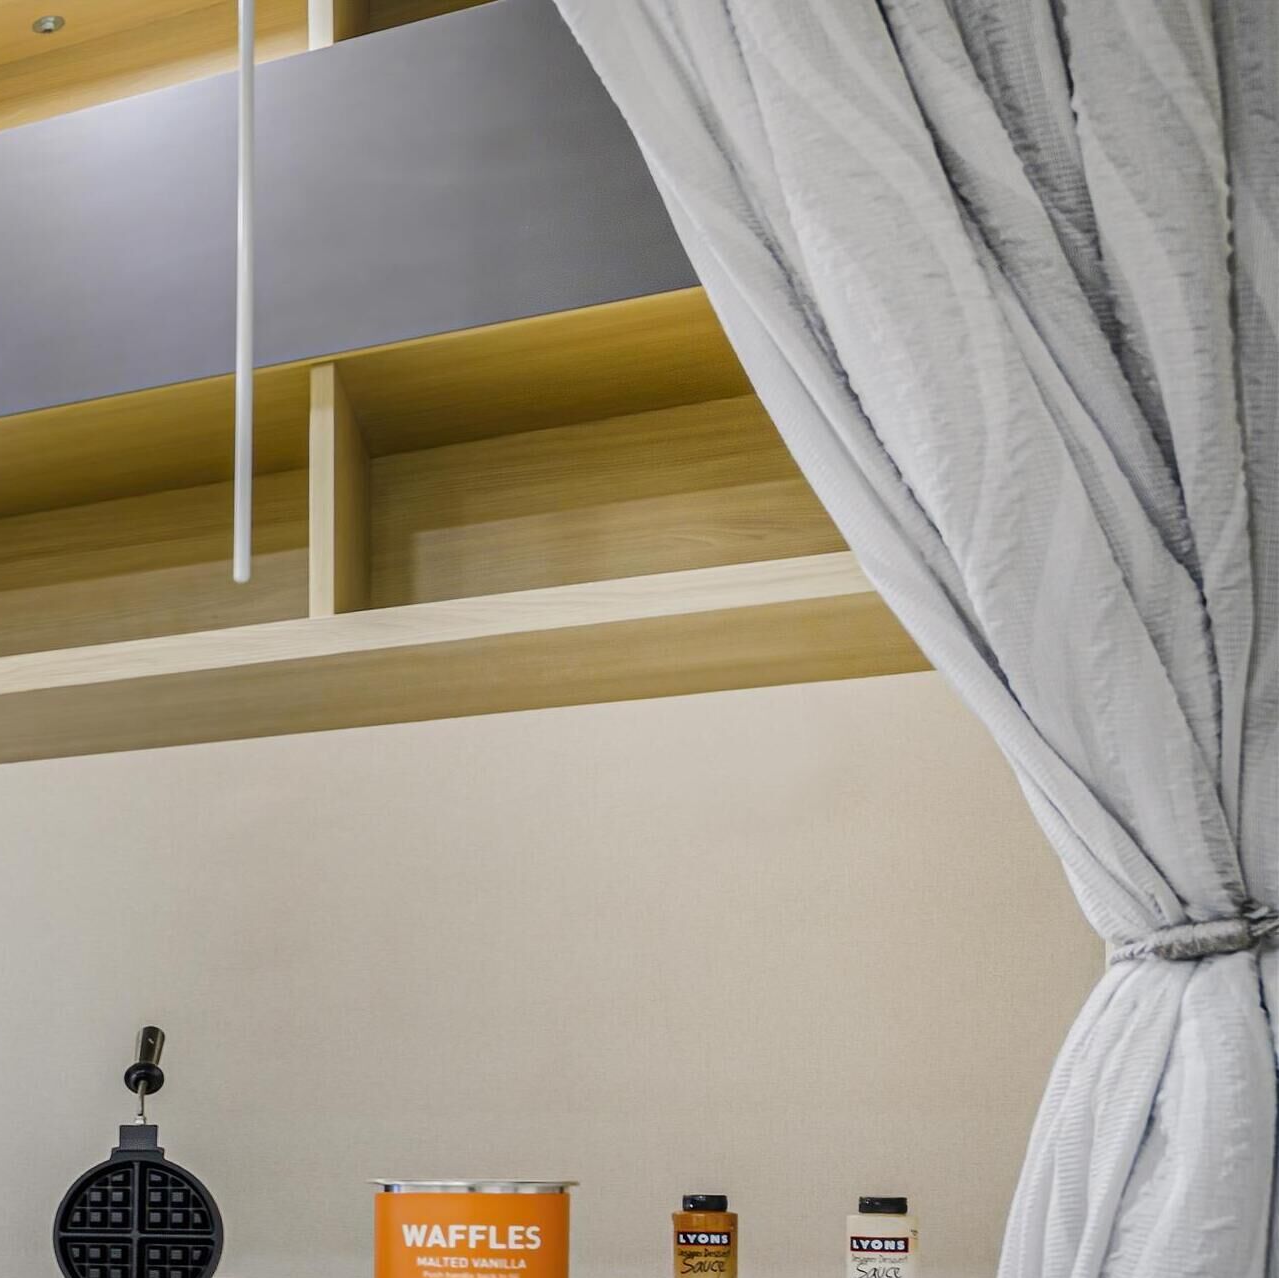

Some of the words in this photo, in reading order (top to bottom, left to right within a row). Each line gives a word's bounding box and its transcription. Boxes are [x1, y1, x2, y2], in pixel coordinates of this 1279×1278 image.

[401, 1224, 542, 1250] WAFFLES
[678, 1233, 729, 1244] LYONS
[852, 1239, 905, 1251] LYONS
[416, 1256, 469, 1268] MALTED
[471, 1257, 527, 1269] VANILLA
